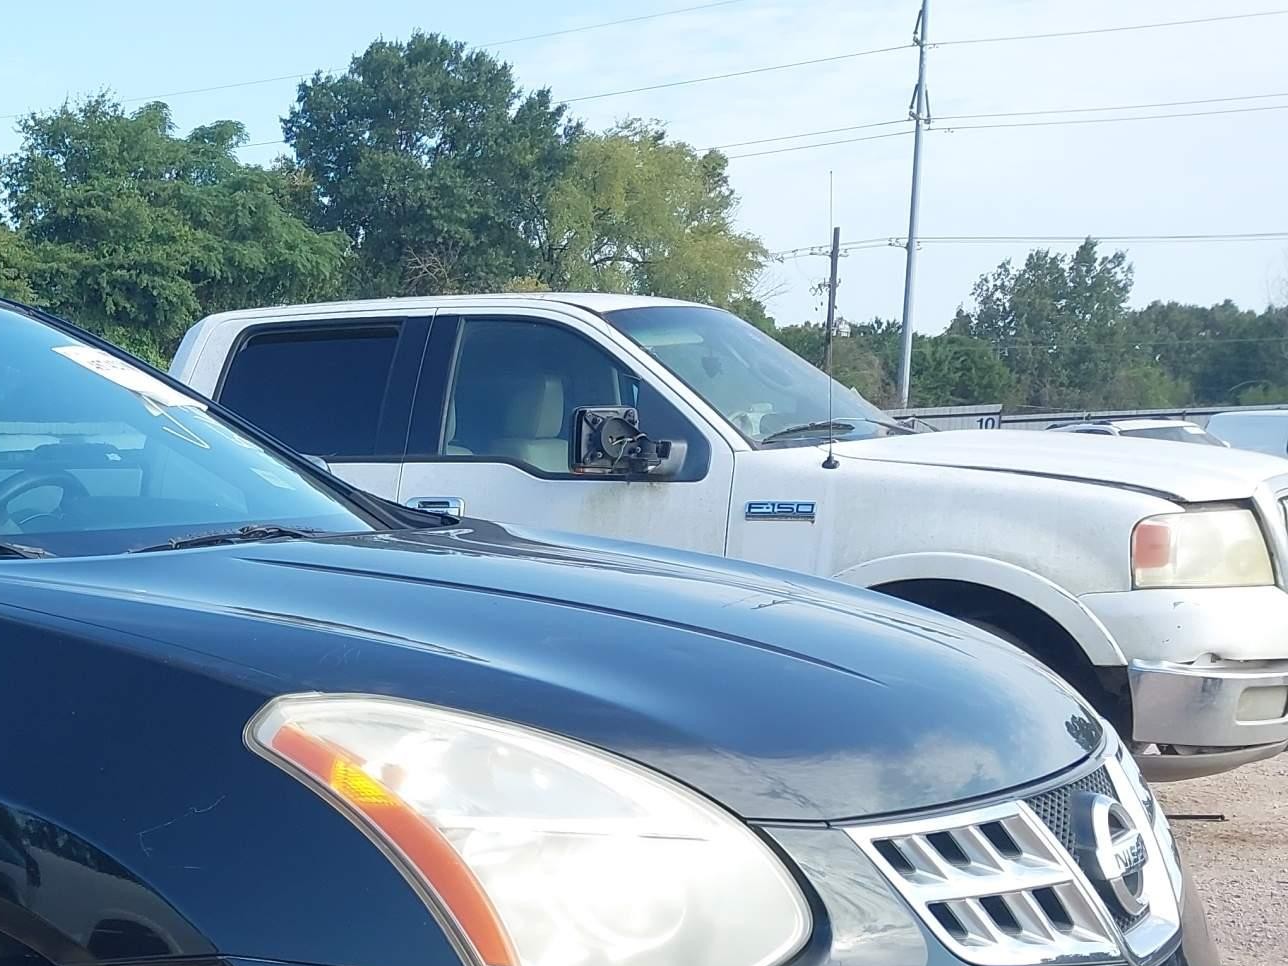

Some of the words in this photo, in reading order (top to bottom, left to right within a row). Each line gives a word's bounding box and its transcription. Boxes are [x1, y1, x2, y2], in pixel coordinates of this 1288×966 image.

[976, 417, 995, 429] 10
[747, 503, 815, 513] F-150
[1115, 841, 1144, 869] NISS
